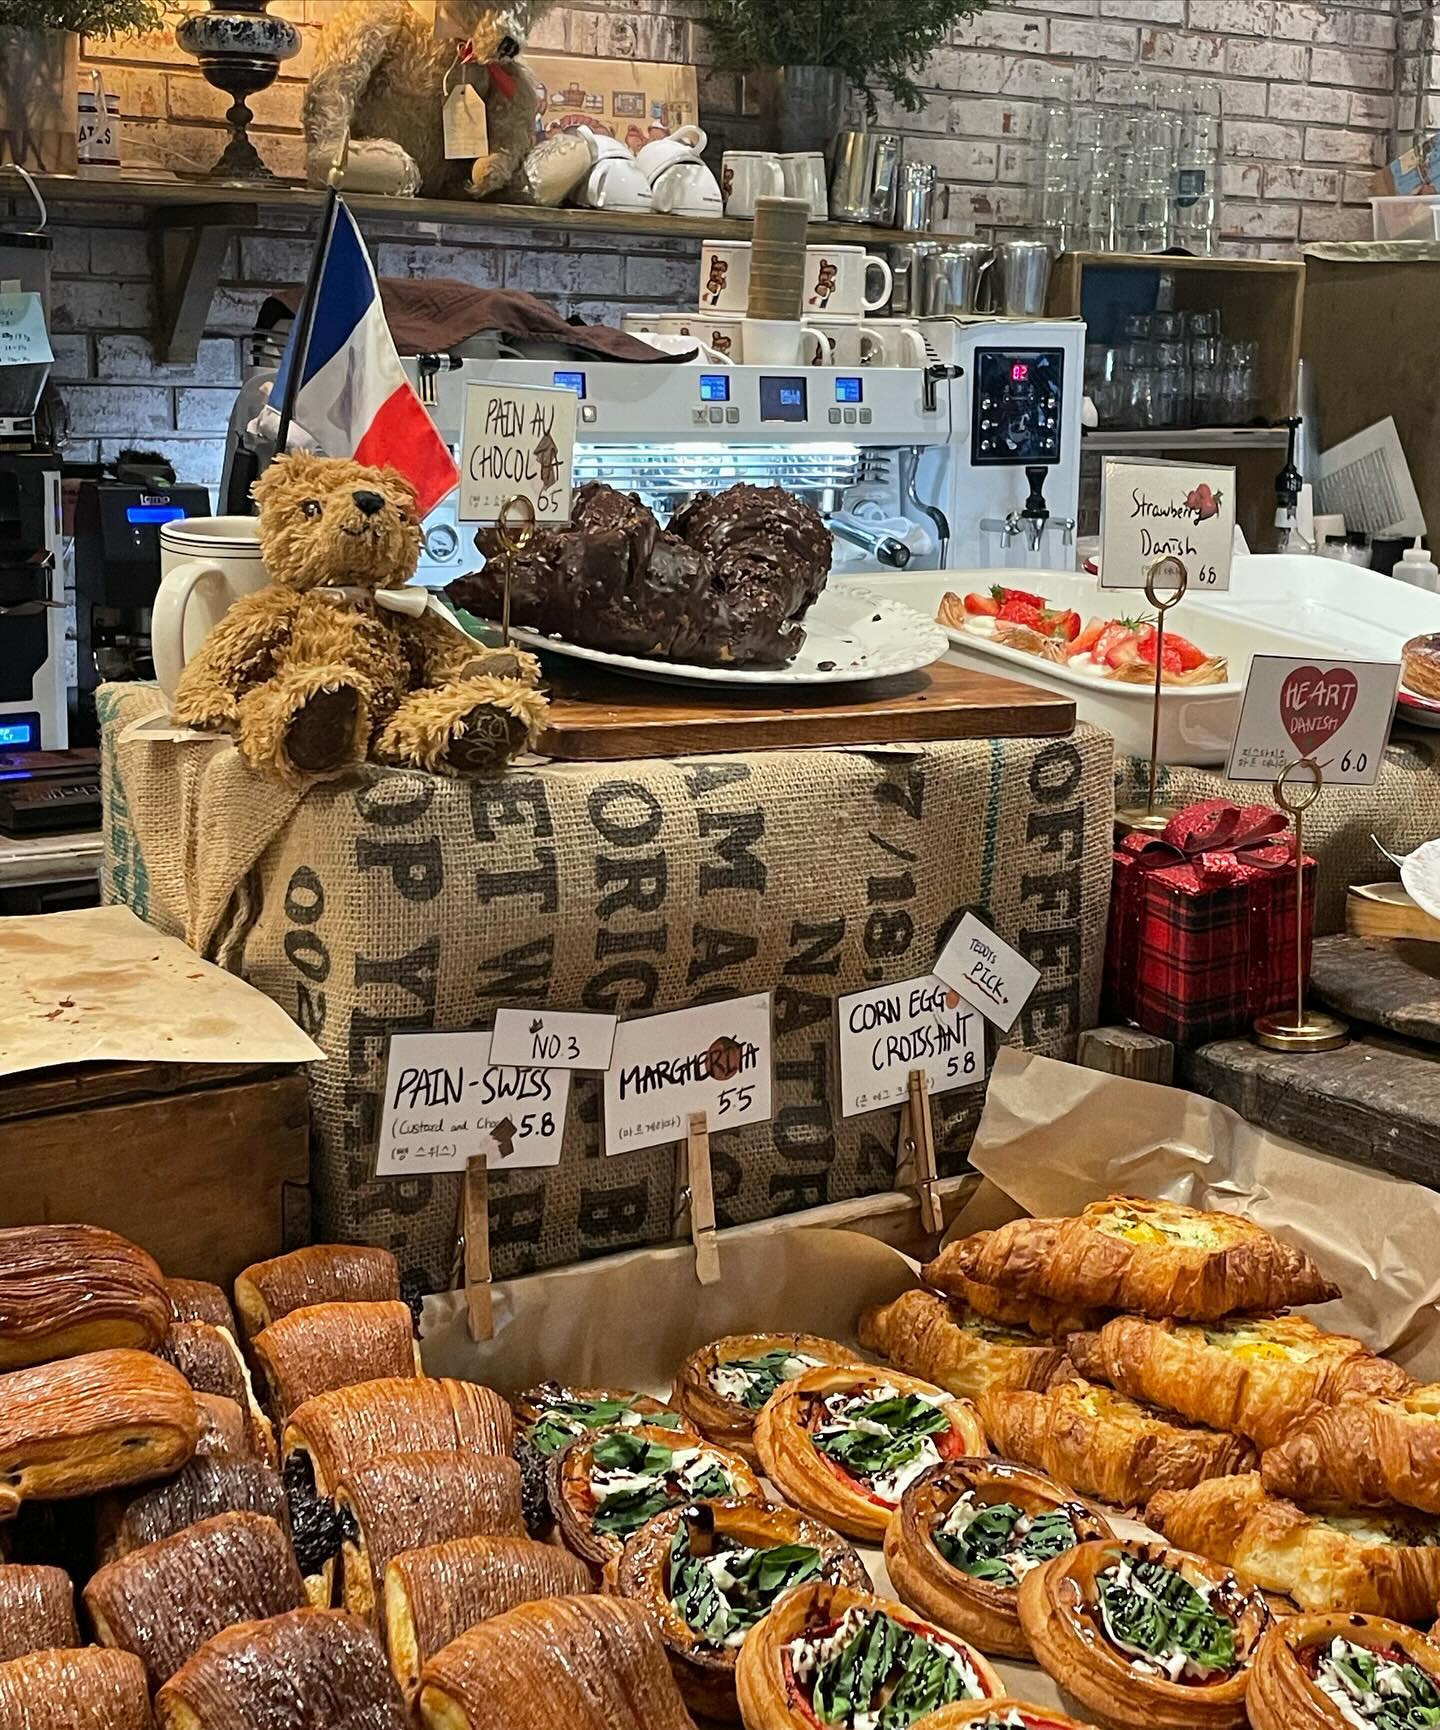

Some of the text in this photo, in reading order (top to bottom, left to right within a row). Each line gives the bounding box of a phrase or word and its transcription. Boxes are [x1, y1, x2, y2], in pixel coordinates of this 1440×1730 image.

[484, 397, 557, 438] PAIN AU
[1130, 487, 1202, 527] Strawberry
[1140, 528, 1197, 557] Danish
[1285, 680, 1356, 711] HEART
[1290, 715, 1339, 735] DANISH
[1340, 748, 1368, 773] 6.0
[970, 961, 1006, 999] PICK
[849, 985, 947, 1035] CORN EGG
[872, 1011, 975, 1071] CROISSANT
[619, 1034, 760, 1101] MARGHERITA
[450, 1123, 468, 1133] and
[518, 1112, 556, 1138] 5.8
